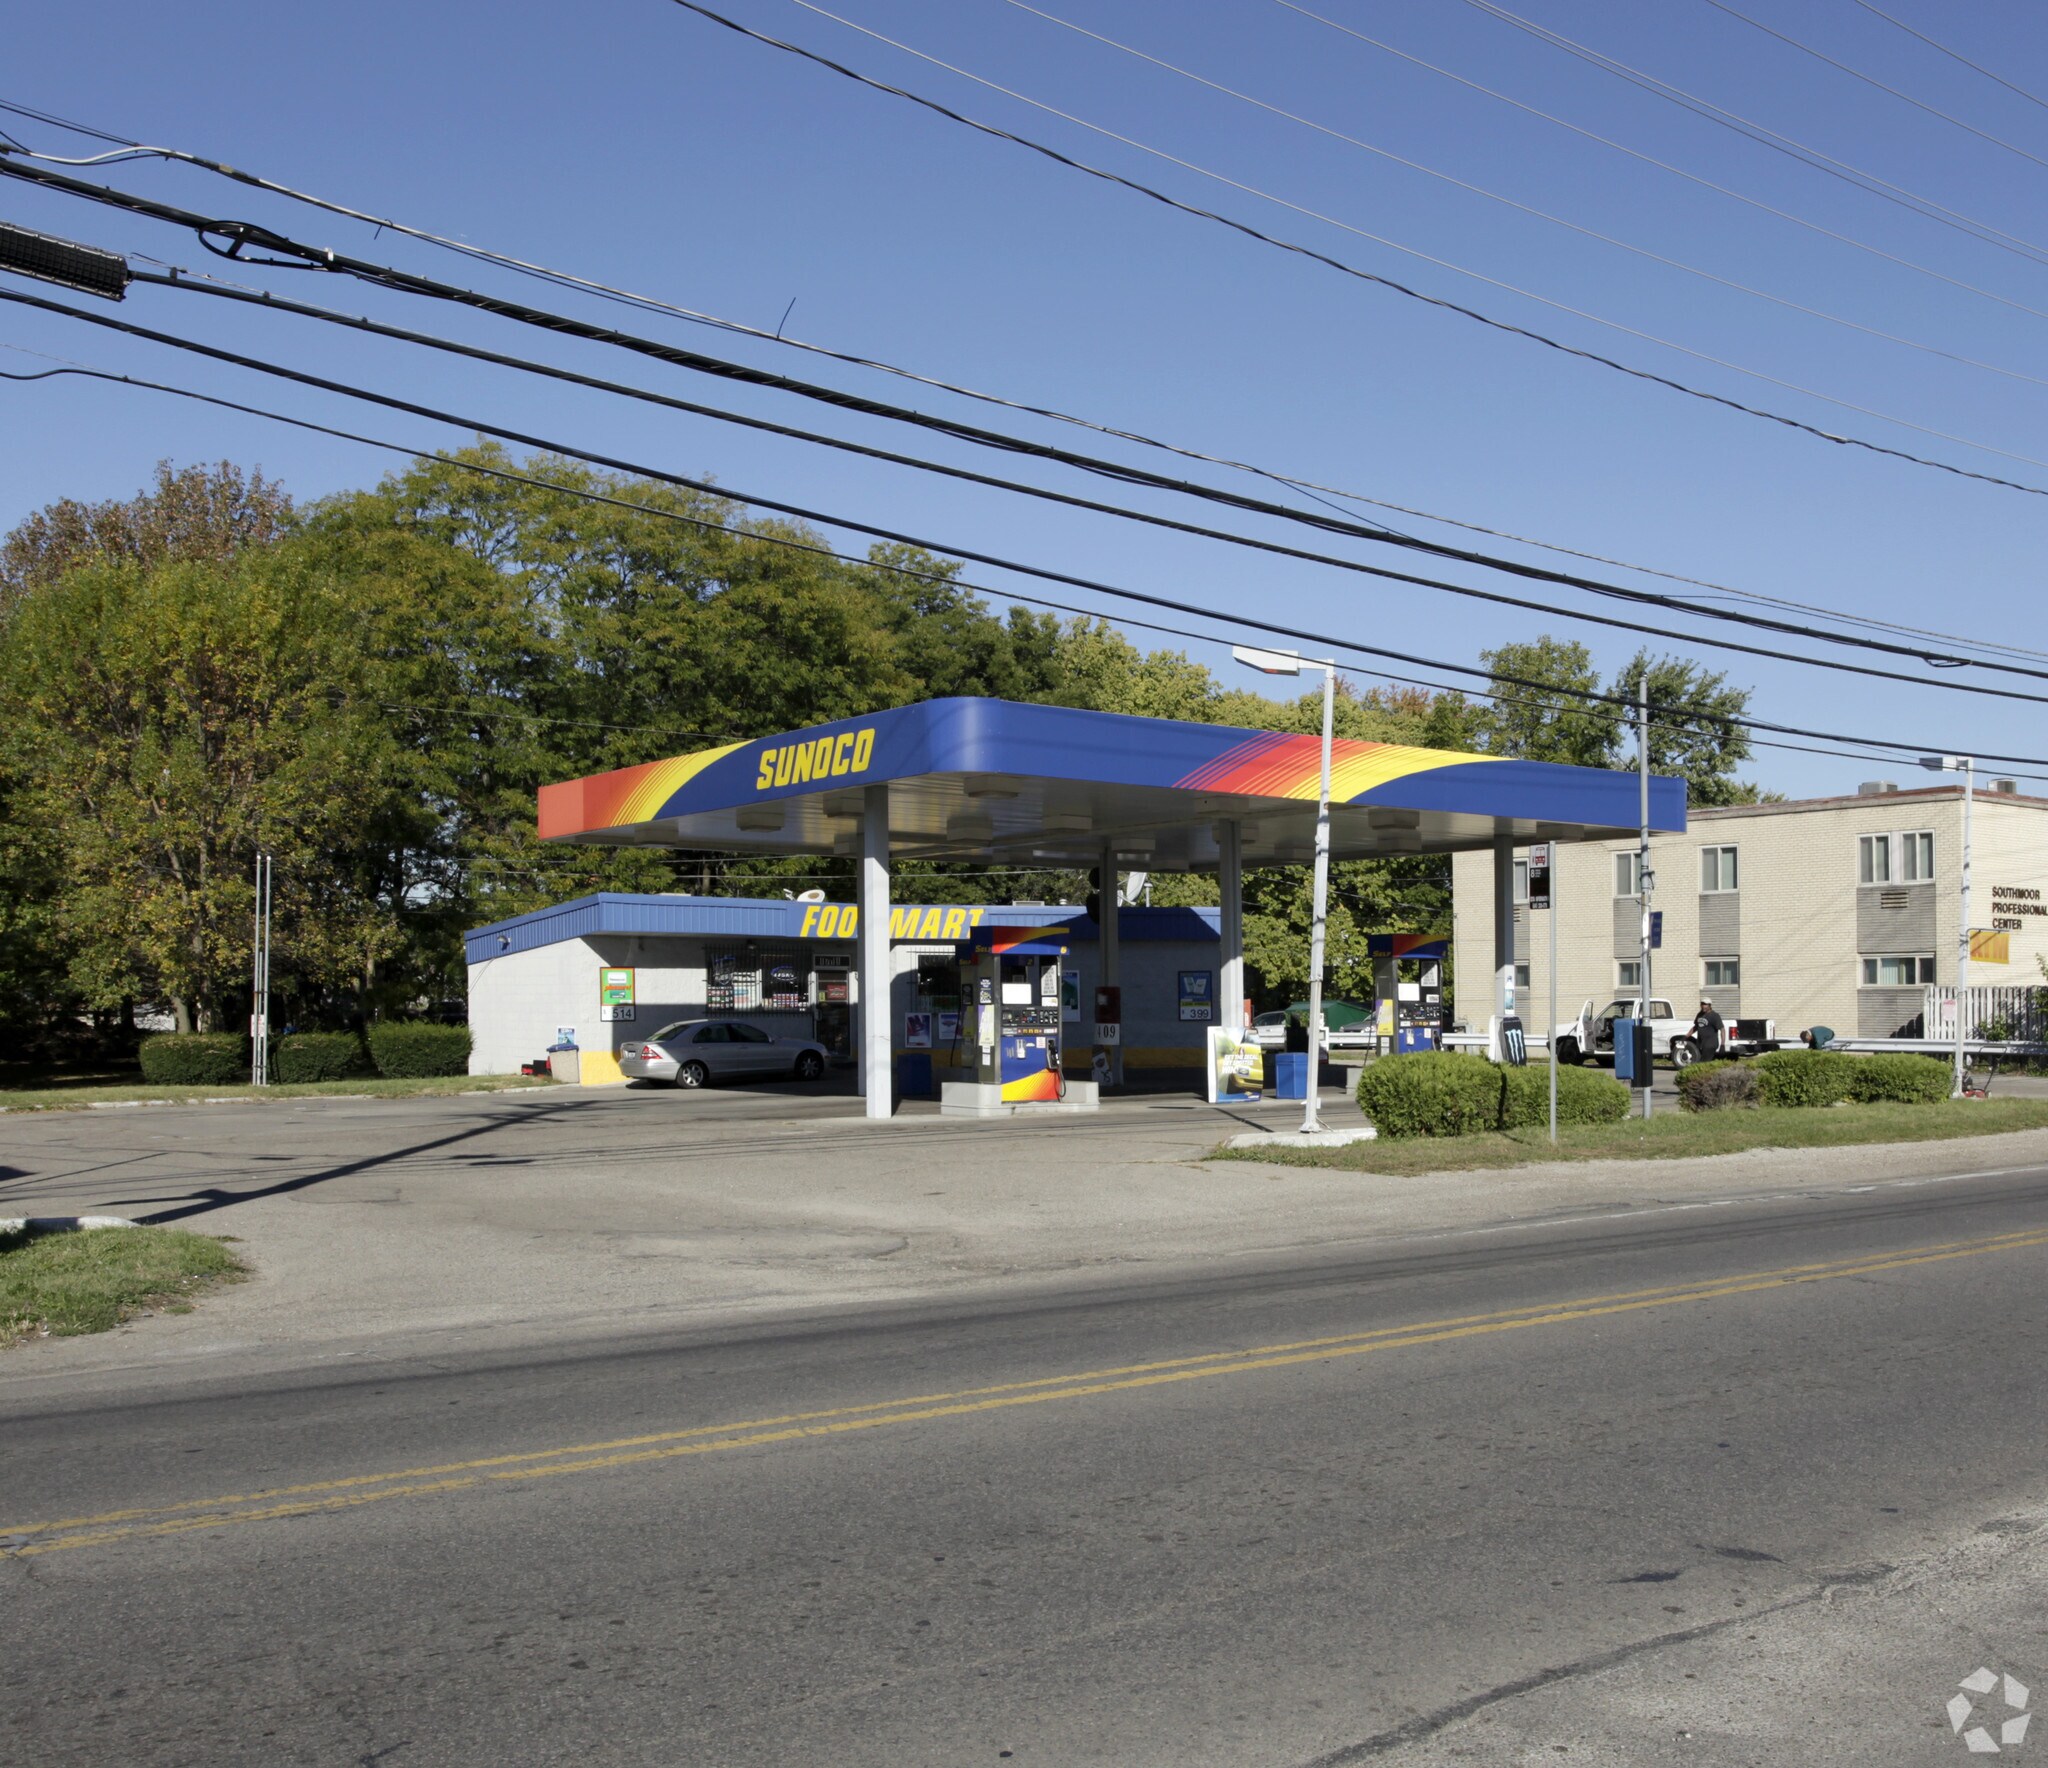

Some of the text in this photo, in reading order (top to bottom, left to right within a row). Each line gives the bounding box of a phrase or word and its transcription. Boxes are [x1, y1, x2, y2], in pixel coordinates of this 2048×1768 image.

[756, 728, 875, 790] SUNOCO
[1530, 869, 1535, 878] 8
[1992, 886, 2040, 900] SOUTHMOOR
[1992, 902, 2048, 916] PROFESSIONAL
[800, 905, 984, 939] FOO MART
[1992, 918, 2022, 930] CENTER
[612, 1009, 632, 1018] 514
[1190, 1009, 1209, 1018] 399
